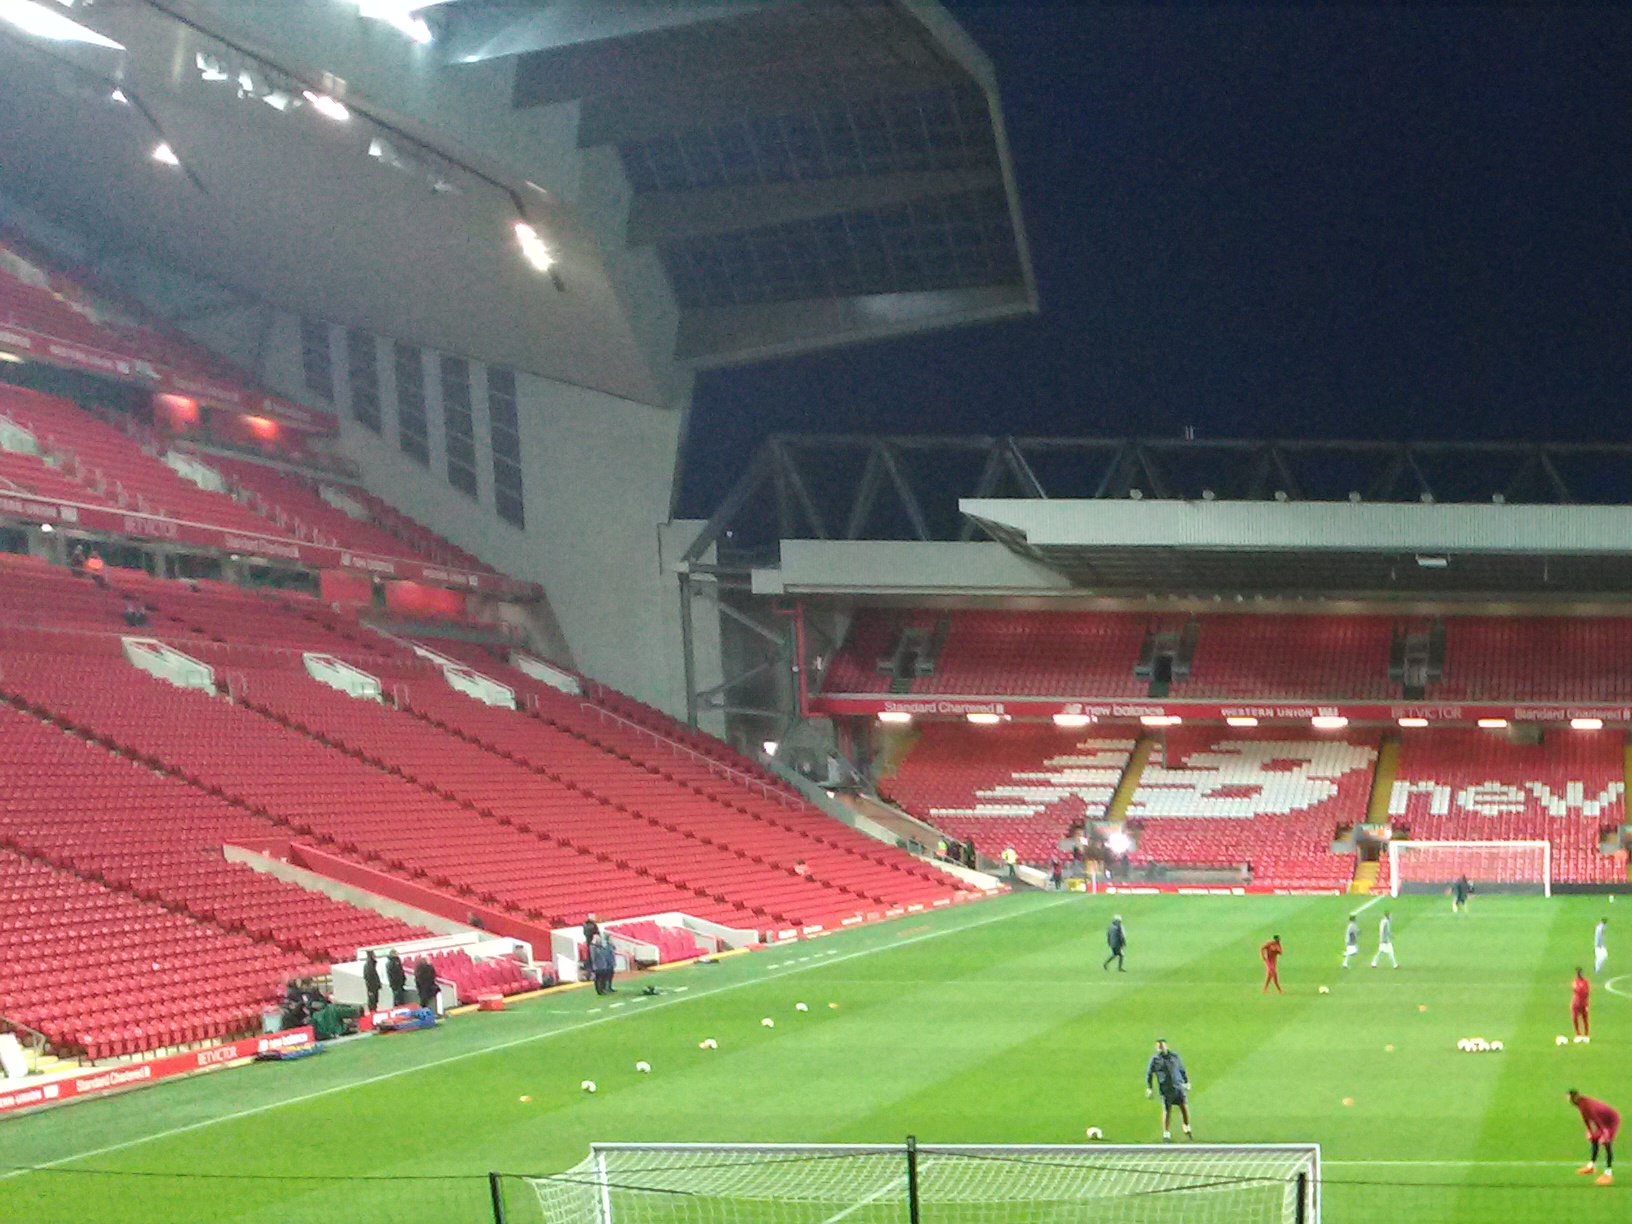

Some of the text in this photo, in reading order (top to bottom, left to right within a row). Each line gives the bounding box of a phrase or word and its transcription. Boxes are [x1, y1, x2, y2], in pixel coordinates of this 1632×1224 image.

[1221, 707, 1273, 717] WESTERN
[1277, 708, 1313, 718] UNION
[1387, 780, 1625, 816] new
